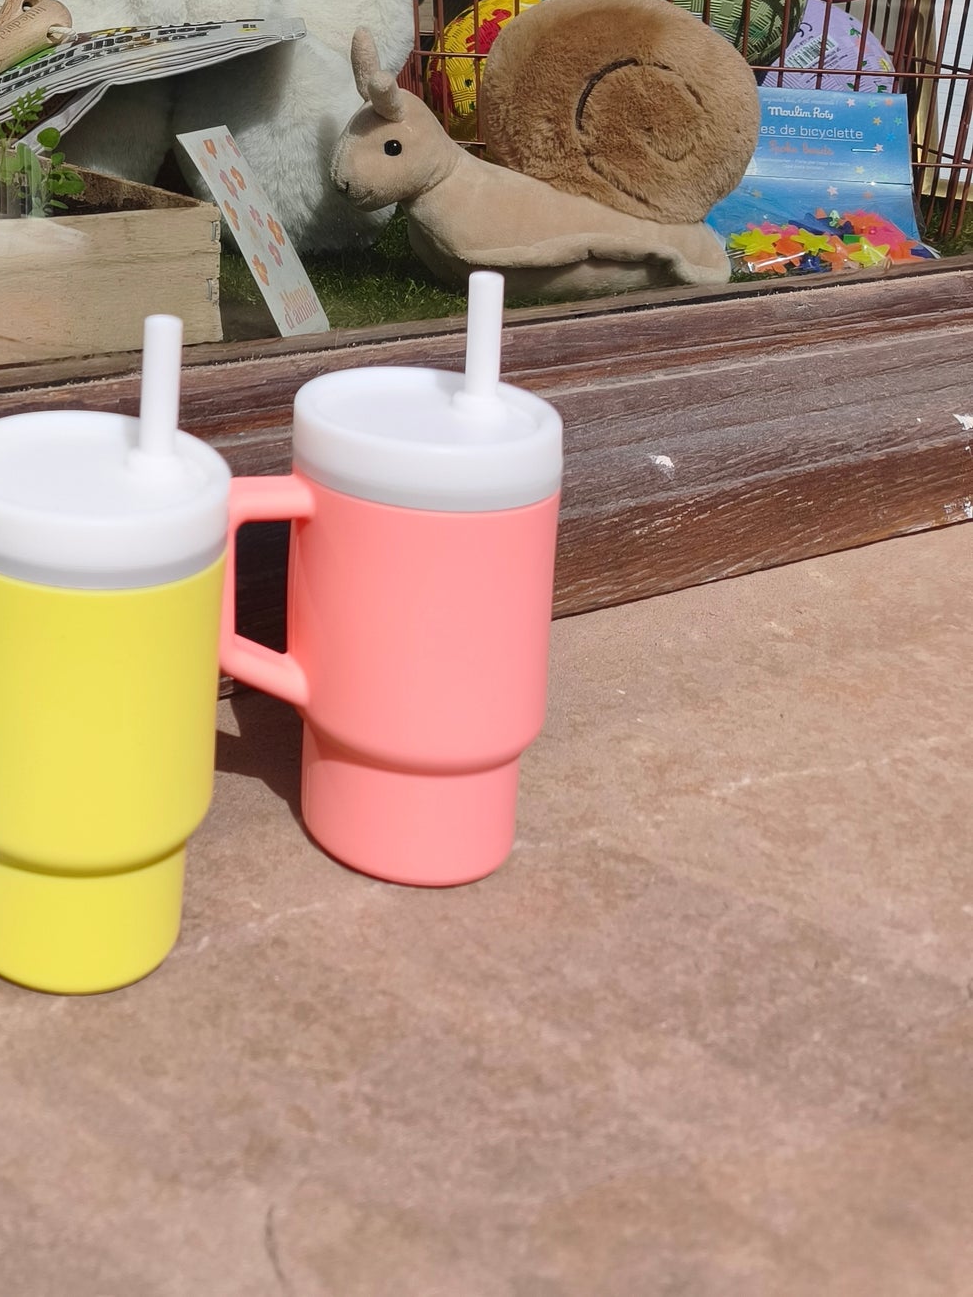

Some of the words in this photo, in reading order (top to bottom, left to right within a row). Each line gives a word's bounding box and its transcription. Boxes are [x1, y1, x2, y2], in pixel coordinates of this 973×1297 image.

[767, 106, 812, 119] Moulin
[813, 107, 834, 120] Roty
[759, 126, 776, 135] es
[780, 125, 796, 135] de
[800, 126, 864, 141] bicyclette
